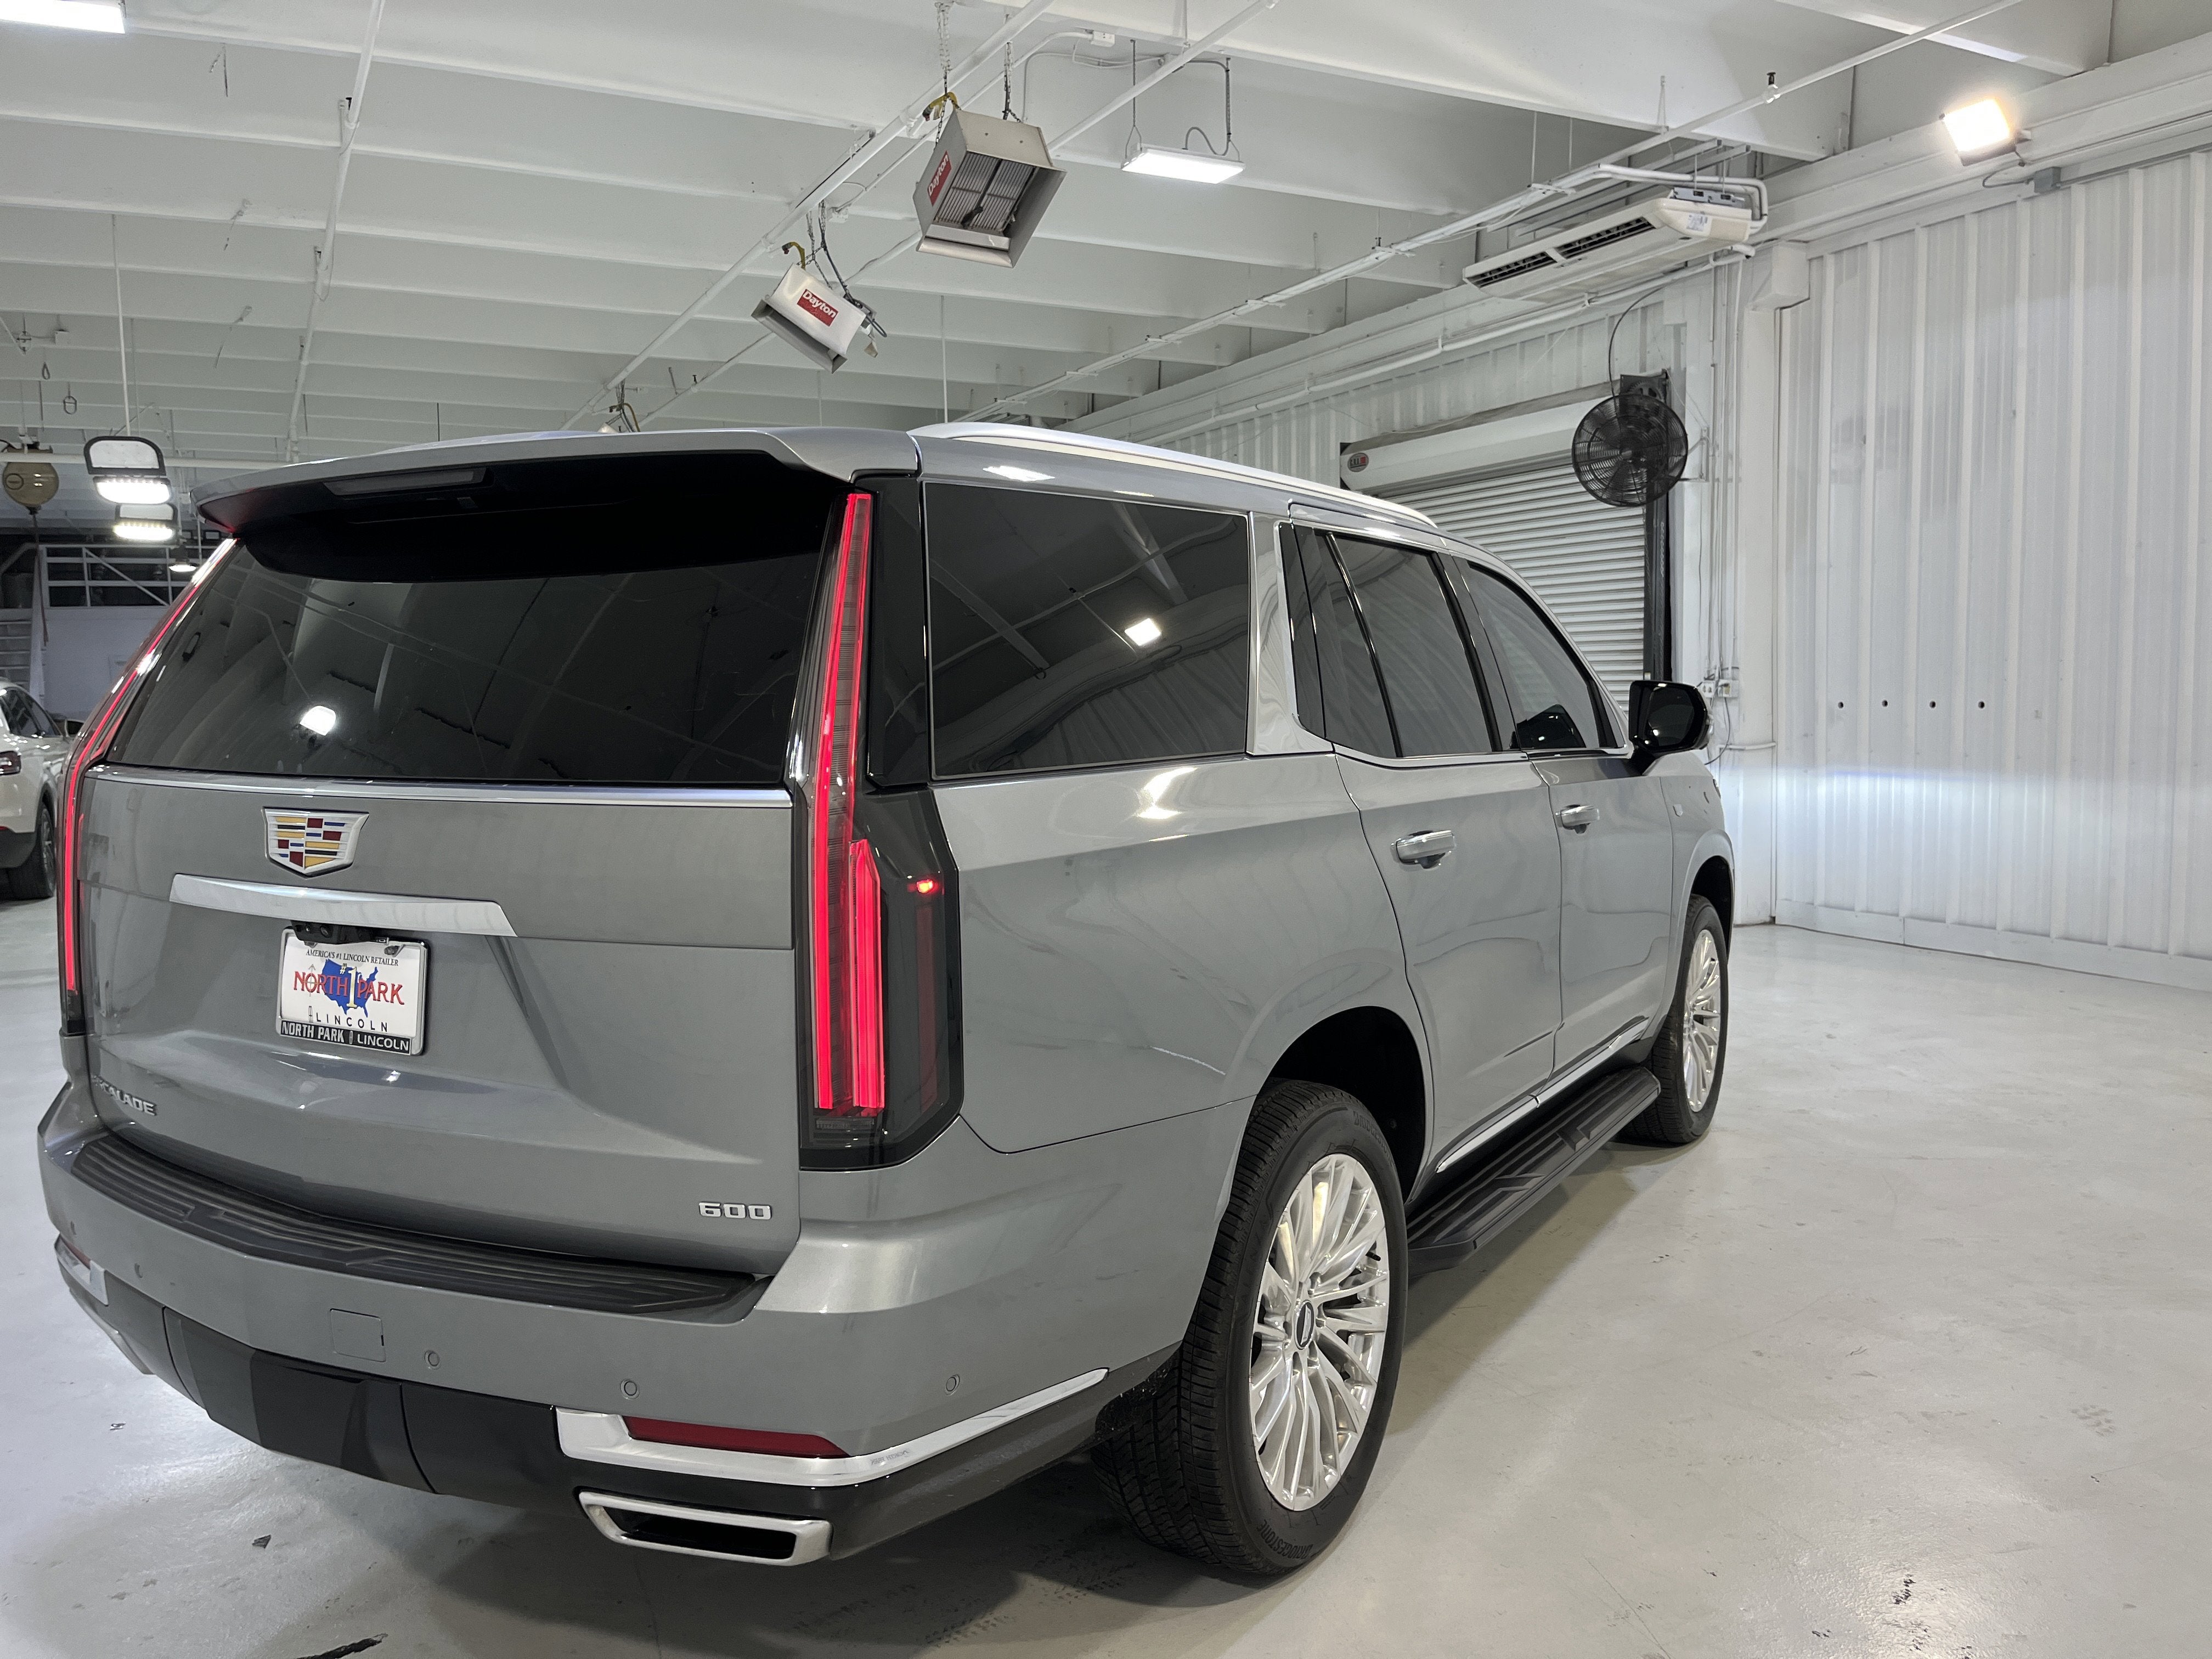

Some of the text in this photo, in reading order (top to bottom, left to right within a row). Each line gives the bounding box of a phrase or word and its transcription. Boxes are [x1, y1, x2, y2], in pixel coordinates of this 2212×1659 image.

[928, 154, 949, 197] Dayton
[802, 290, 837, 318] Dayton
[306, 949, 335, 958] AMERICA'S
[343, 953, 370, 963] LINCOLN
[370, 957, 399, 966] RETAILER
[293, 970, 405, 1005] NORTH PARK
[281, 1021, 409, 1051] NORTH PARK LINCOLN
[315, 1012, 388, 1032] LINCOLN
[698, 1201, 772, 1220] 600
[1256, 1519, 1314, 1559] BRIDGESTONE
